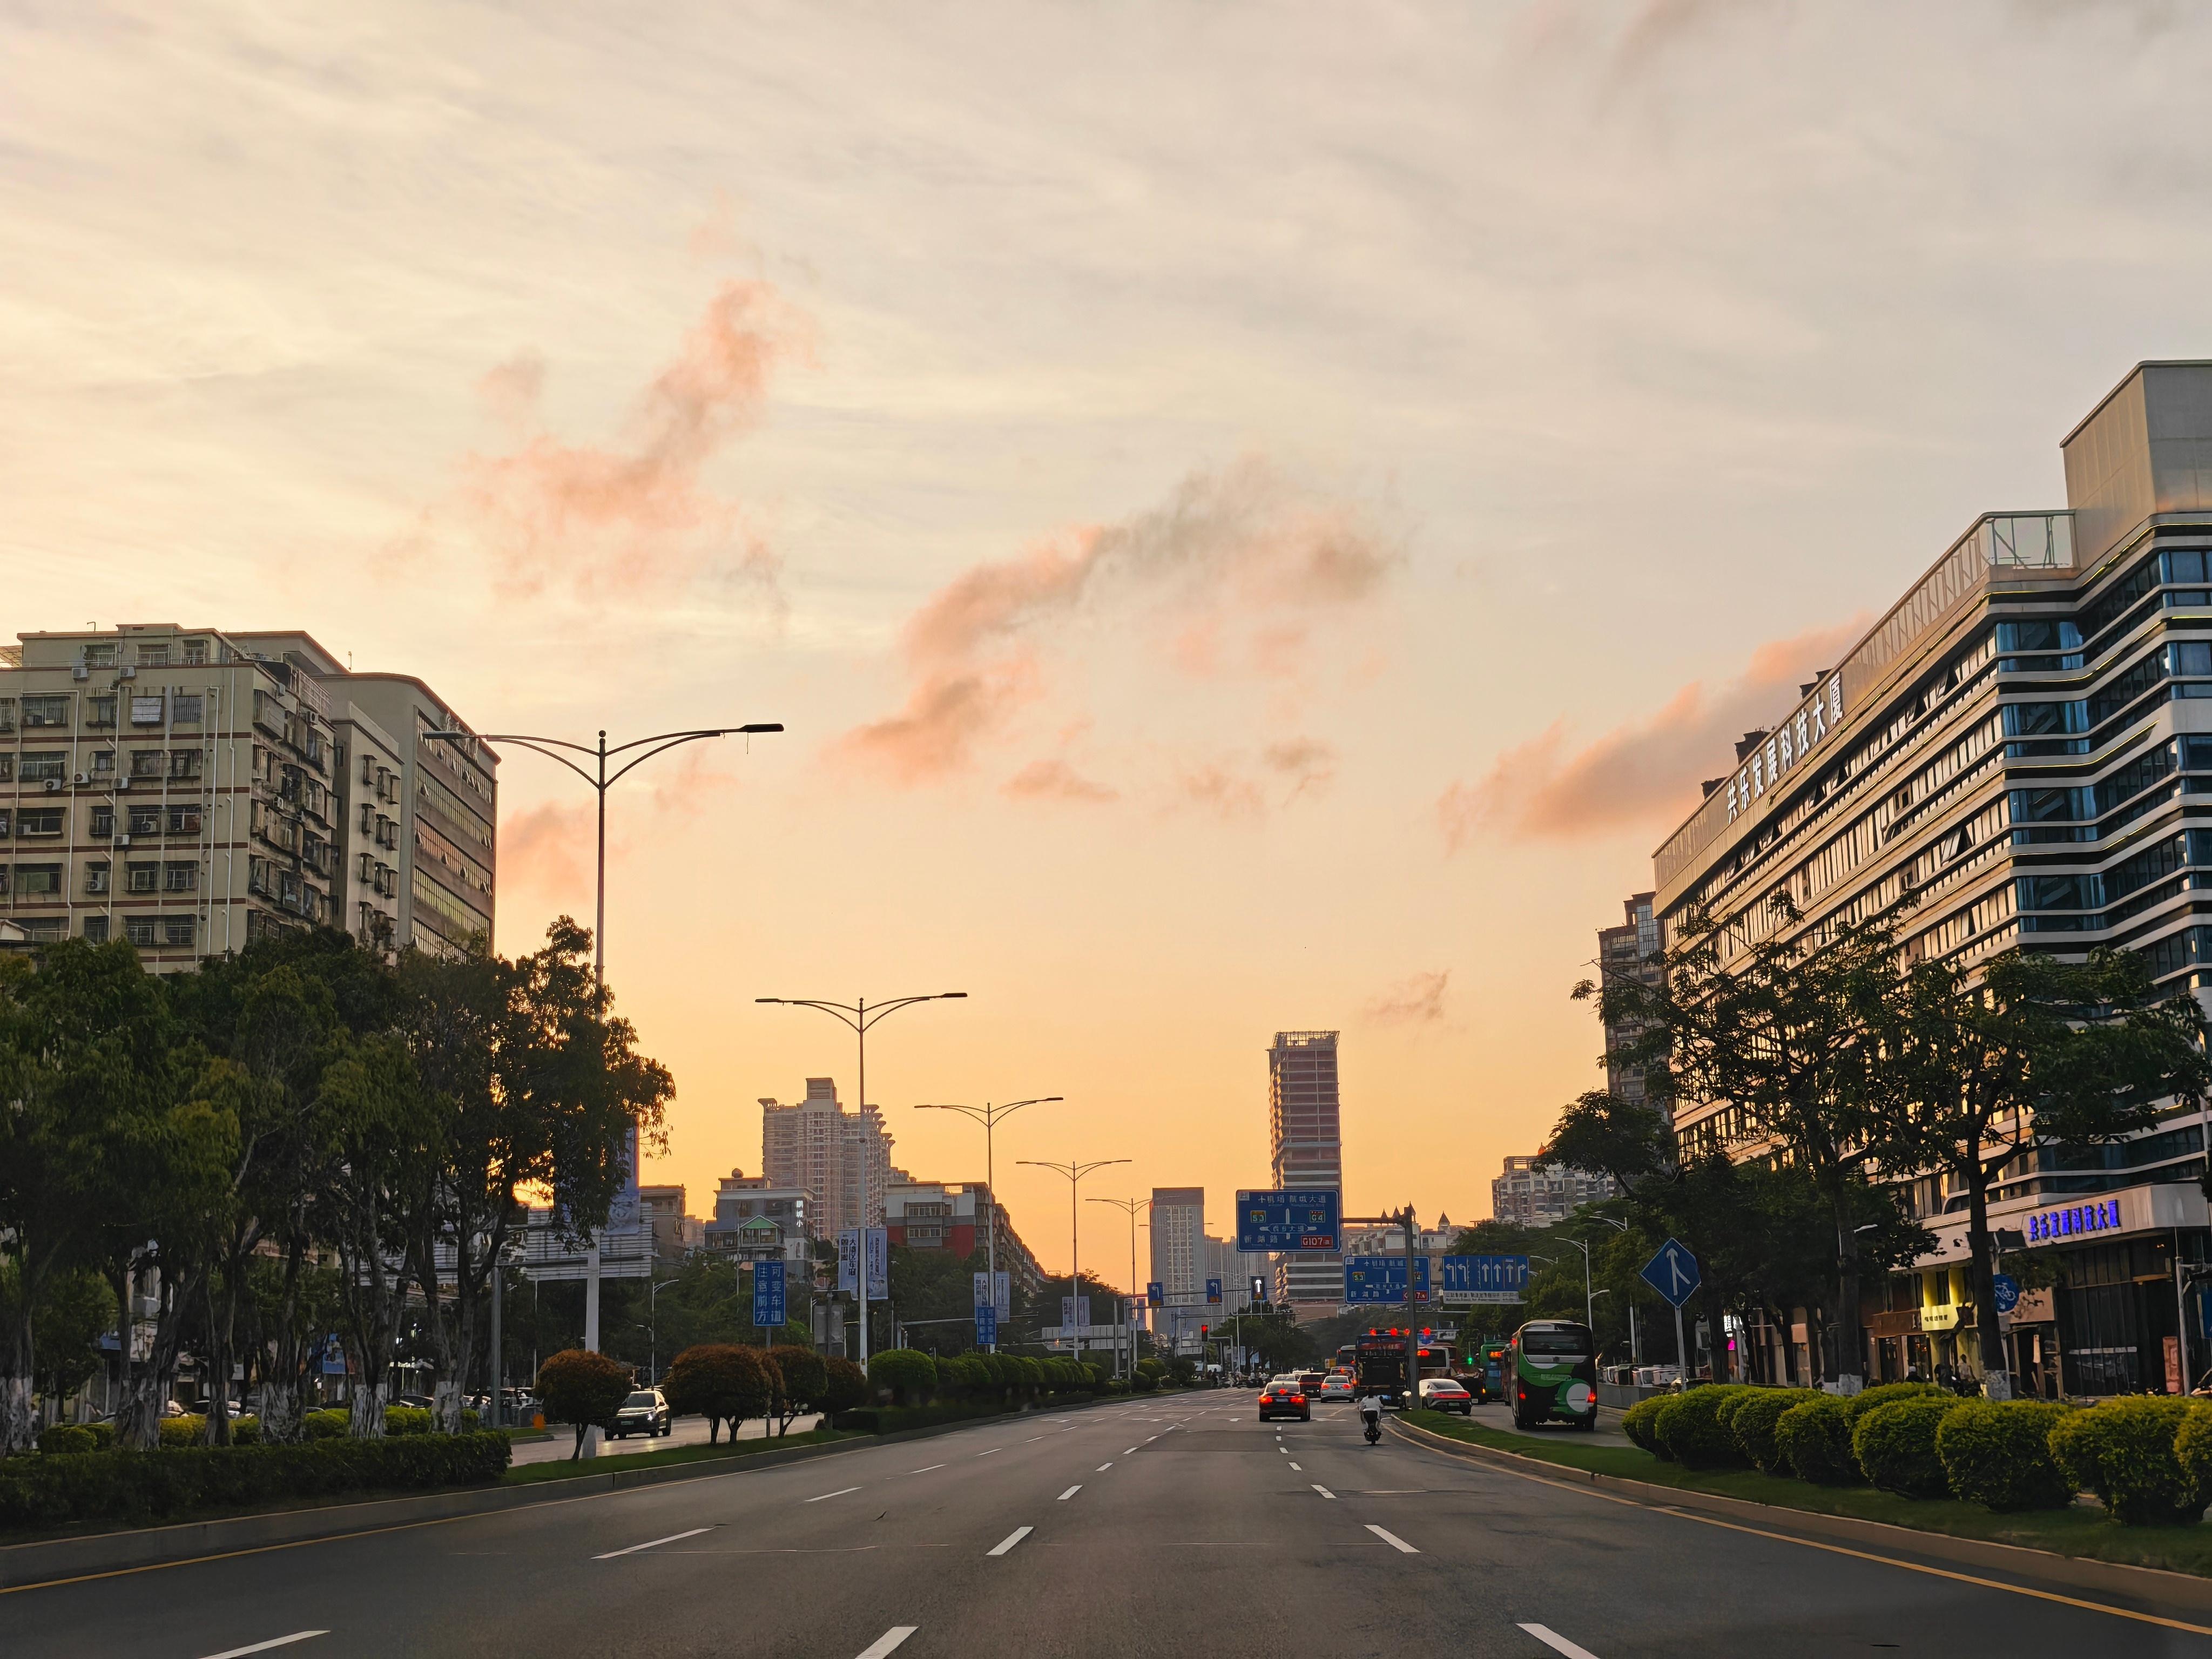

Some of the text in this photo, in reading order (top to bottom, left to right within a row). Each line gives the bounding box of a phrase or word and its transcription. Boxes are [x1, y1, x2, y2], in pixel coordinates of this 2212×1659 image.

[1727, 671, 1843, 825] 共乐发展科技大厦
